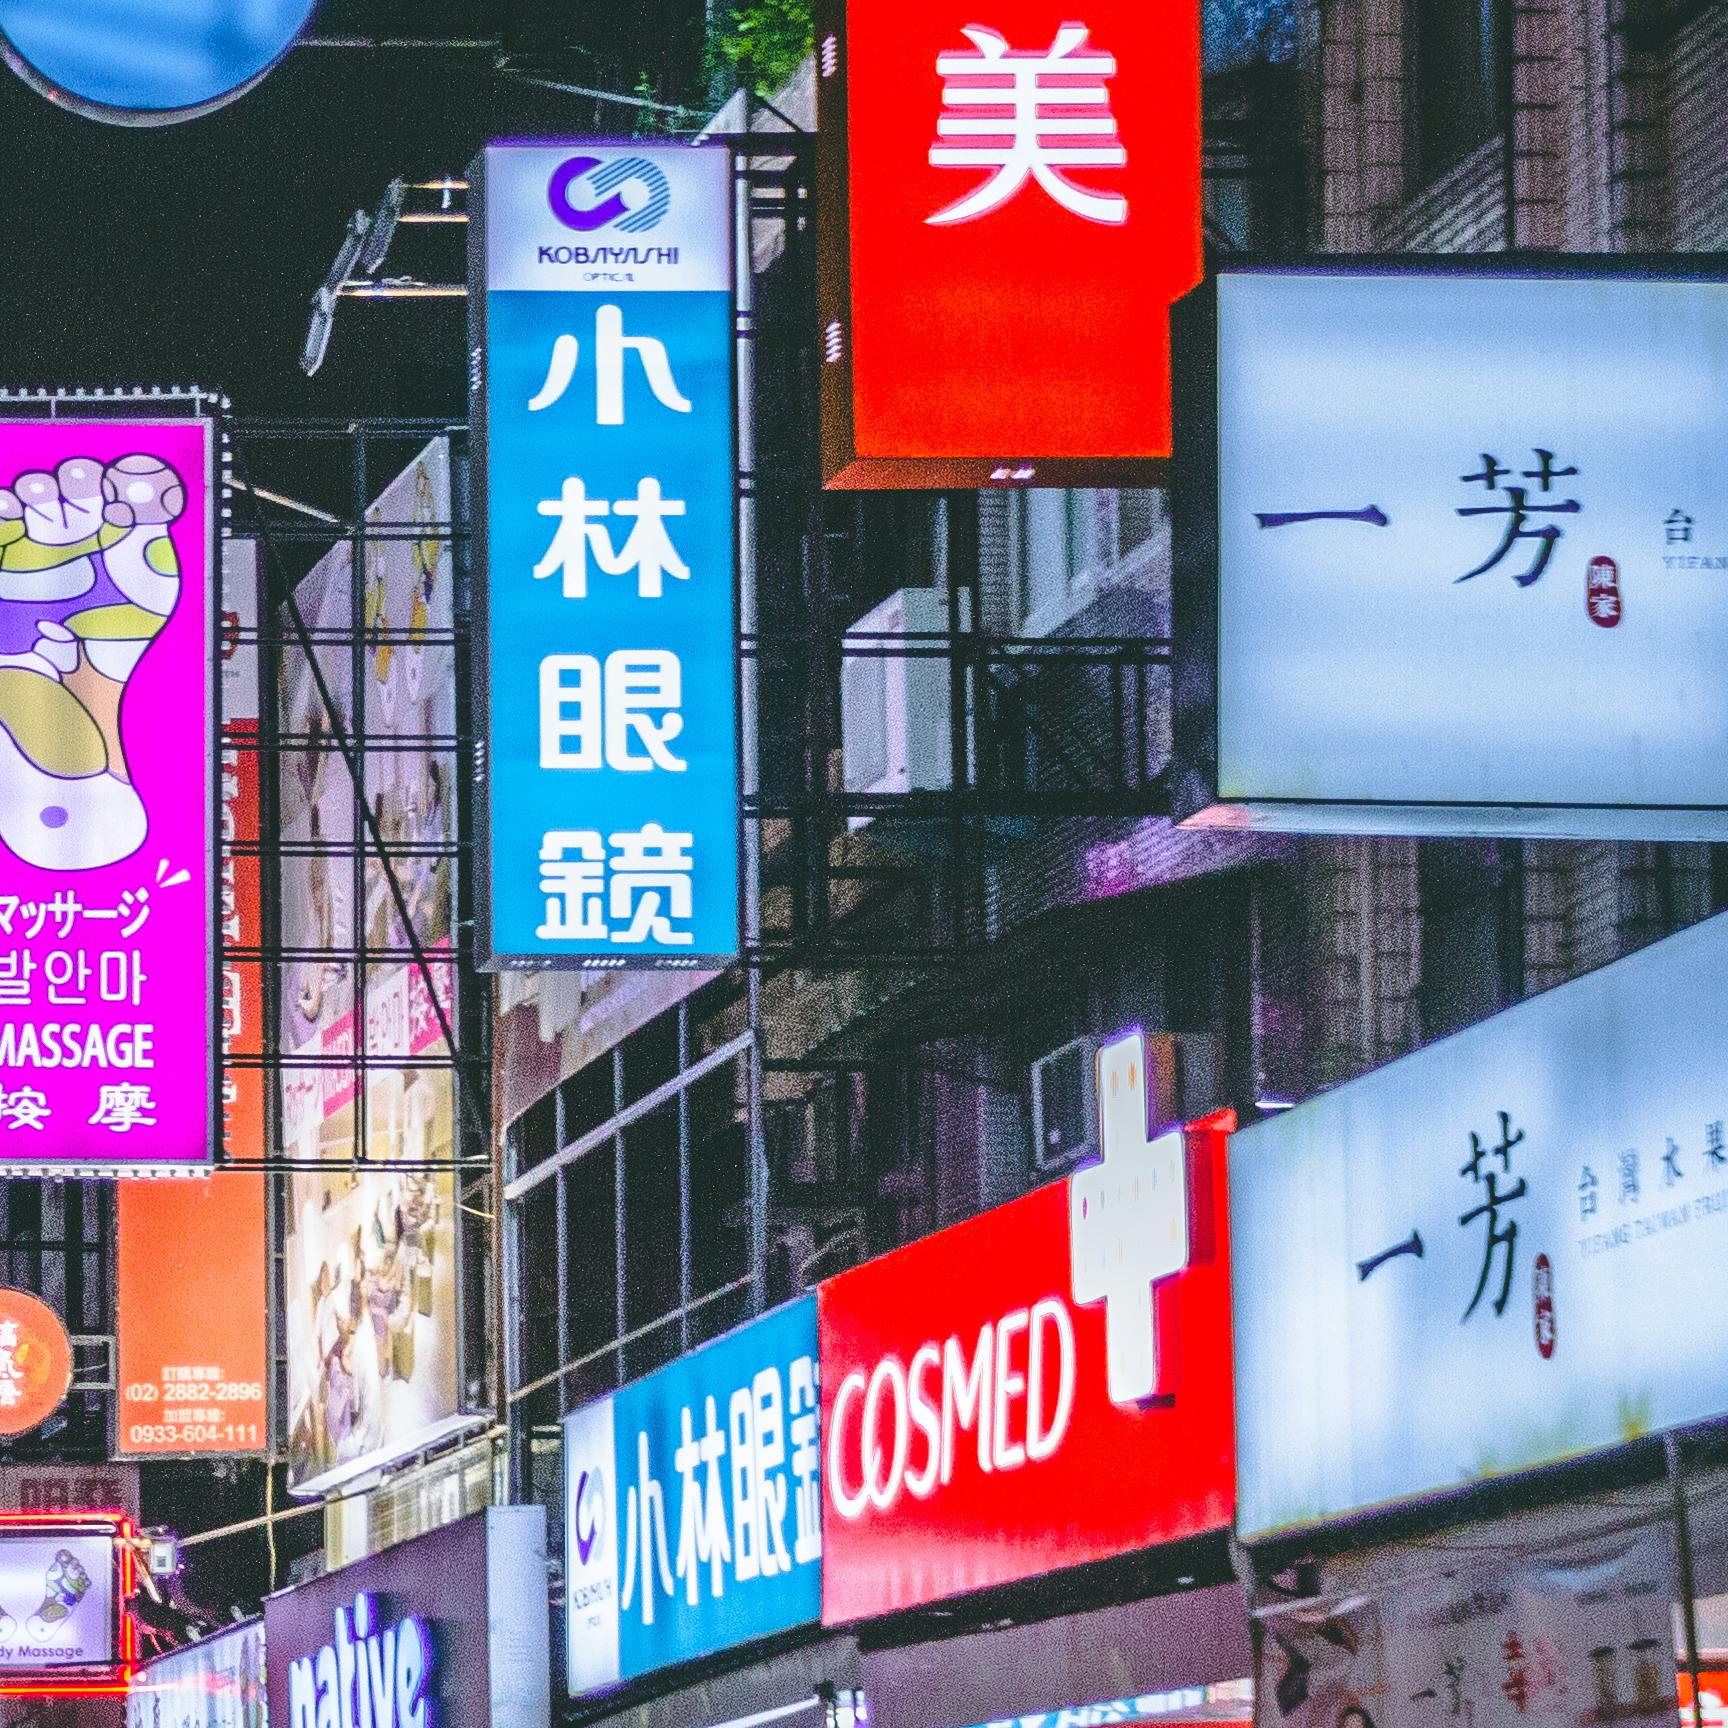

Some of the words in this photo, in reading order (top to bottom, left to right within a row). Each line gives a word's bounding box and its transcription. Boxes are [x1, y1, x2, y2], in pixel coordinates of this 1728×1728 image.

[924, 23, 1129, 226] 美
[537, 245, 680, 266] KOBAYASHI
[1252, 448, 1581, 588] 一芳
[528, 303, 694, 946] 小林眼鏡
[1356, 1111, 1526, 1325] 一芳
[125, 1382, 159, 1401] (02)
[163, 1382, 262, 1401] 2882-2896
[130, 1424, 258, 1444] 0933-604-111
[828, 1298, 1074, 1519] COSMED
[18, 1644, 84, 1662] Massage
